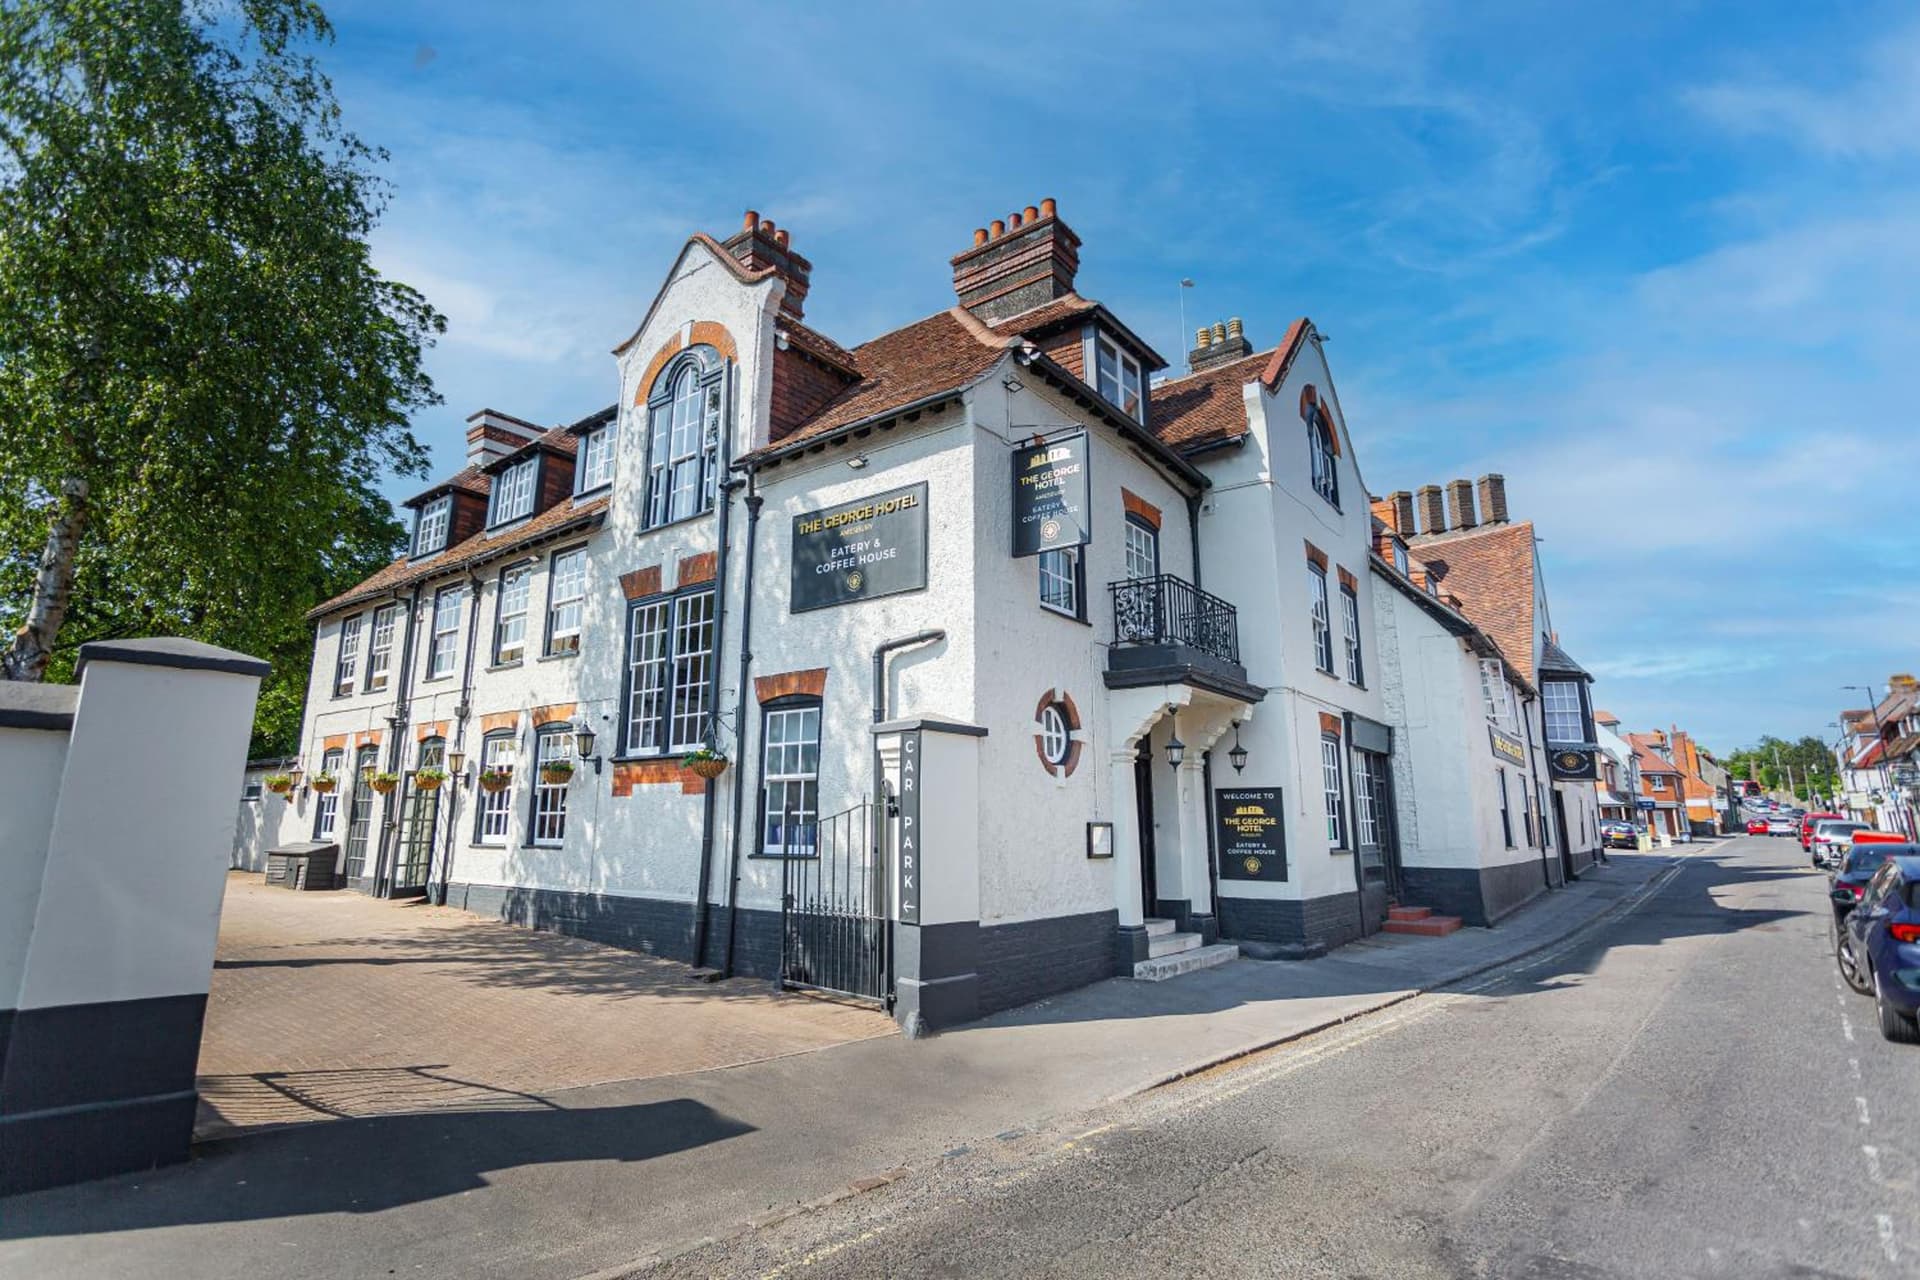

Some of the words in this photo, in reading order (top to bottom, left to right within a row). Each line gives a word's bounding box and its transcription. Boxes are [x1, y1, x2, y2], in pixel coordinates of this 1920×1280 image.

[1021, 474, 1040, 486] THE
[1041, 464, 1080, 480] GEORGE
[1035, 477, 1065, 490] HOTEL
[799, 520, 822, 535] THE
[823, 505, 874, 529] GEORGE
[874, 494, 919, 516] HOTEL
[1022, 511, 1051, 523] COFFEE
[1032, 502, 1060, 513] EATERY
[831, 540, 871, 558] EATERY
[873, 538, 881, 547] &
[815, 557, 856, 574] COFFEE
[858, 548, 897, 565] HOUSE
[904, 740, 914, 791] CAR
[1241, 817, 1277, 825] GEORGE
[903, 816, 913, 889] PARK
